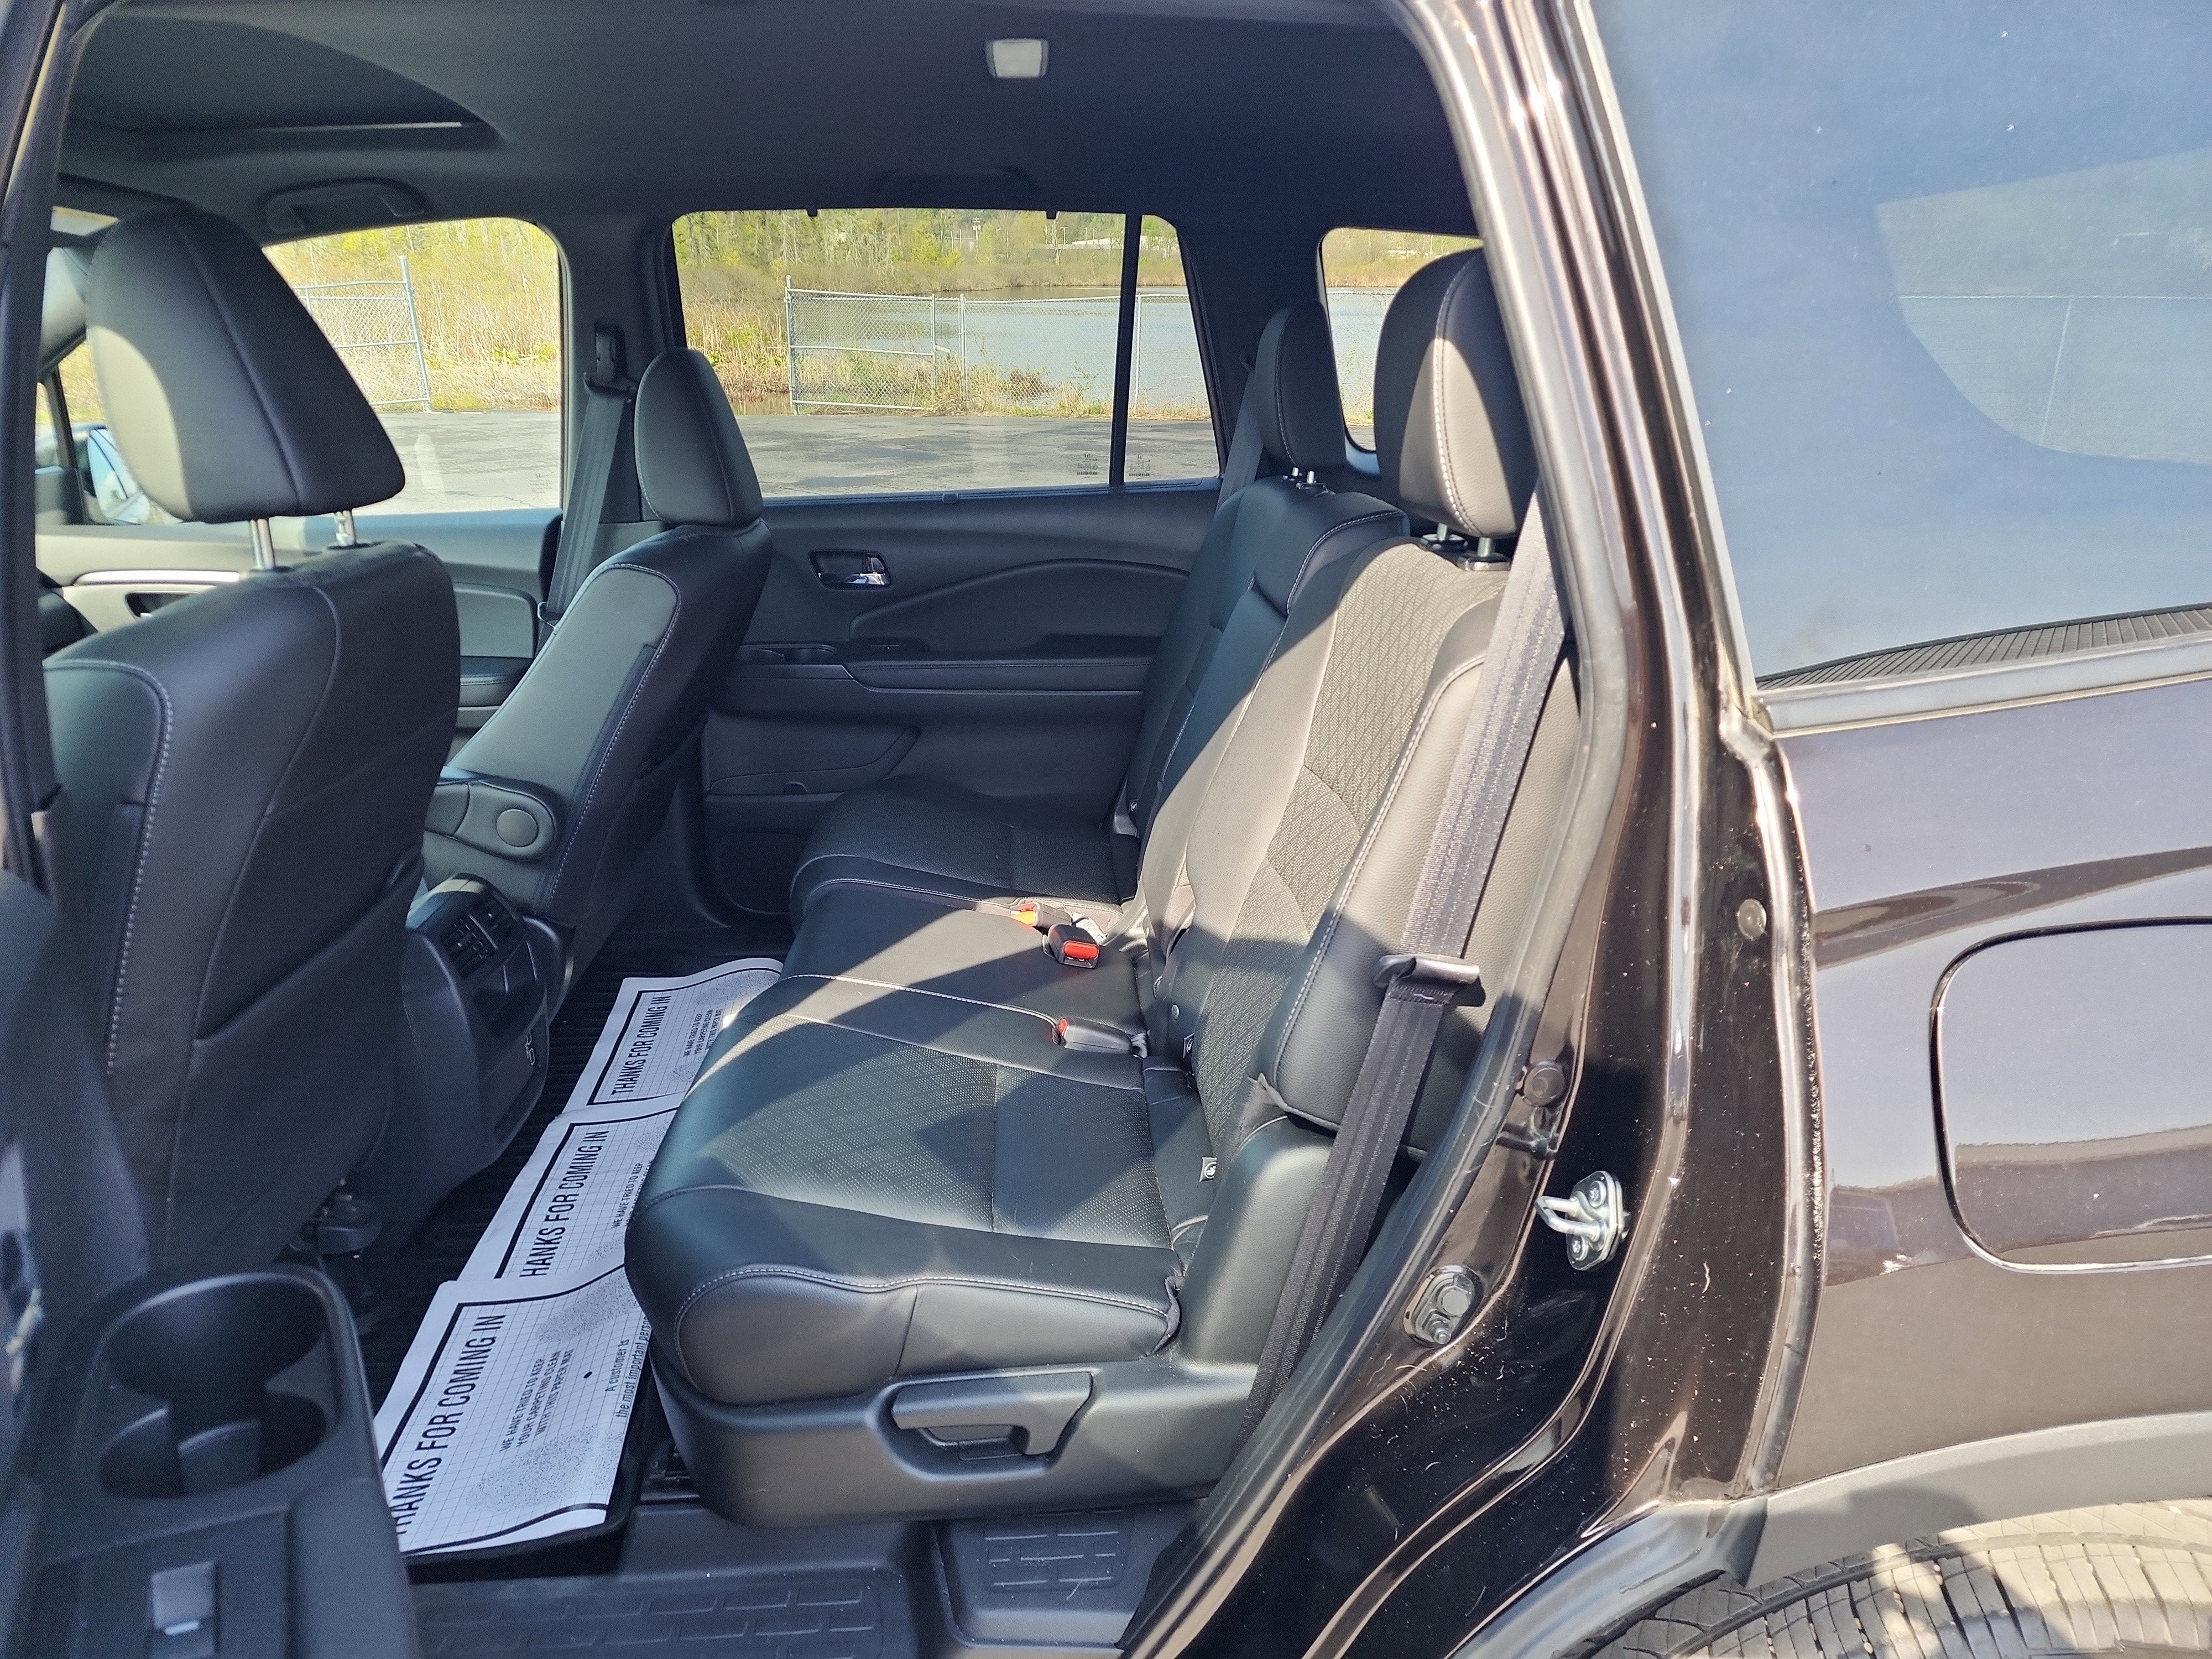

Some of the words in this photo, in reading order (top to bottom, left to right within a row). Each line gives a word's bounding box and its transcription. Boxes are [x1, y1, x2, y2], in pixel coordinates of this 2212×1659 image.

[651, 995, 672, 1004] IN
[637, 1006, 668, 1038] COMING
[628, 1040, 654, 1057] FOR
[611, 1059, 646, 1095] THANKS
[583, 1131, 609, 1141] IN
[558, 1145, 603, 1189] COMING
[631, 1163, 643, 1175] KEEP
[621, 1184, 634, 1201] TRIED
[544, 1193, 580, 1222] FOR
[615, 1202, 629, 1218] HAVE
[611, 1218, 623, 1229] WE
[519, 1227, 566, 1277] HANKS
[473, 1315, 507, 1332] IN
[639, 1316, 650, 1342] perso
[437, 1337, 497, 1407] COMING
[530, 1358, 545, 1377] KEEP
[609, 1347, 627, 1384] customer
[625, 1342, 645, 1380] important
[525, 1377, 538, 1389] TO
[534, 1411, 552, 1437] WITH
[543, 1391, 559, 1414] THIS
[551, 1365, 568, 1392] PAPER
[560, 1348, 574, 1366] MAT
[622, 1381, 635, 1401] most
[515, 1389, 533, 1413] TRIED
[516, 1421, 535, 1447] YOUR
[526, 1376, 551, 1421] CARPETING
[544, 1350, 561, 1376] CLEAN
[615, 1405, 629, 1418] the
[415, 1412, 463, 1452] FOR
[505, 1413, 524, 1436] HAVE
[499, 1437, 515, 1452] WE
[390, 1457, 442, 1535] HANKS
